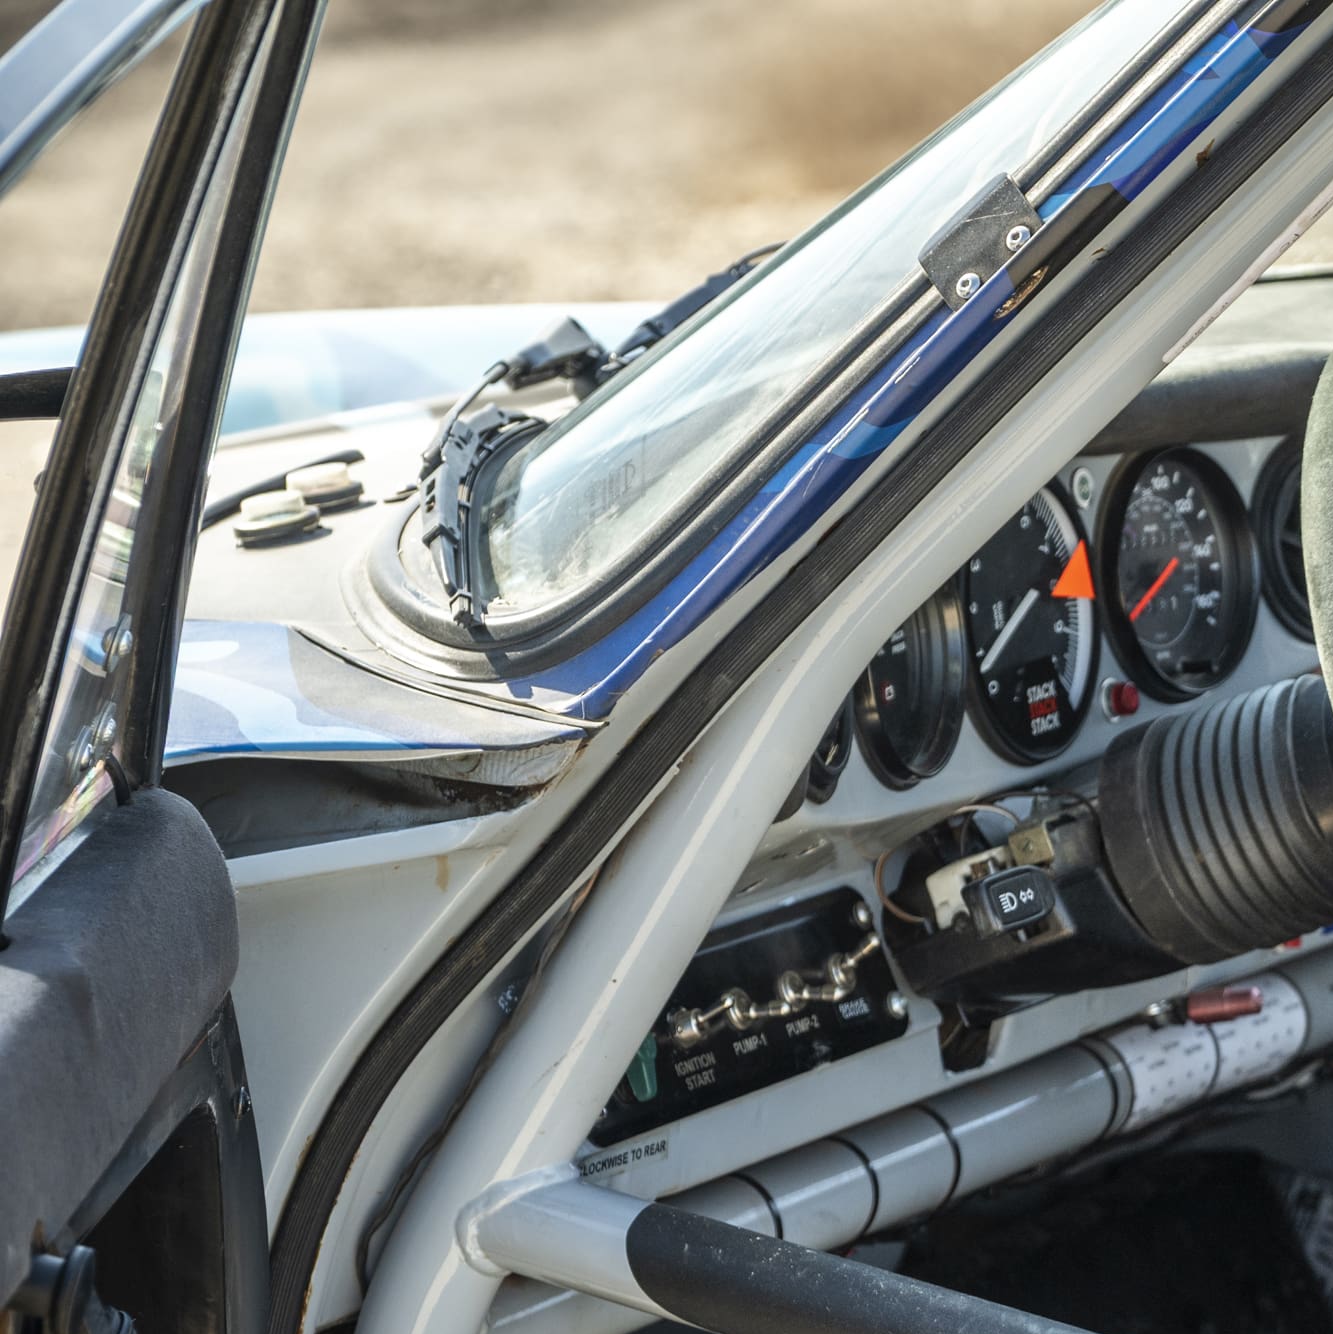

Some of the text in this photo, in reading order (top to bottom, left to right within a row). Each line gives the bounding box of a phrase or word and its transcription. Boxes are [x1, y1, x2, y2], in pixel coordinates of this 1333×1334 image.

[1027, 681, 1056, 703] STACK
[1031, 711, 1060, 735] STACK
[785, 1014, 821, 1037] PUMP-2
[733, 1034, 768, 1056] PUMP-1
[675, 1051, 716, 1077] IGNITION
[685, 1069, 716, 1091] START
[631, 1146, 643, 1162] TO
[644, 1140, 667, 1158] REAR
